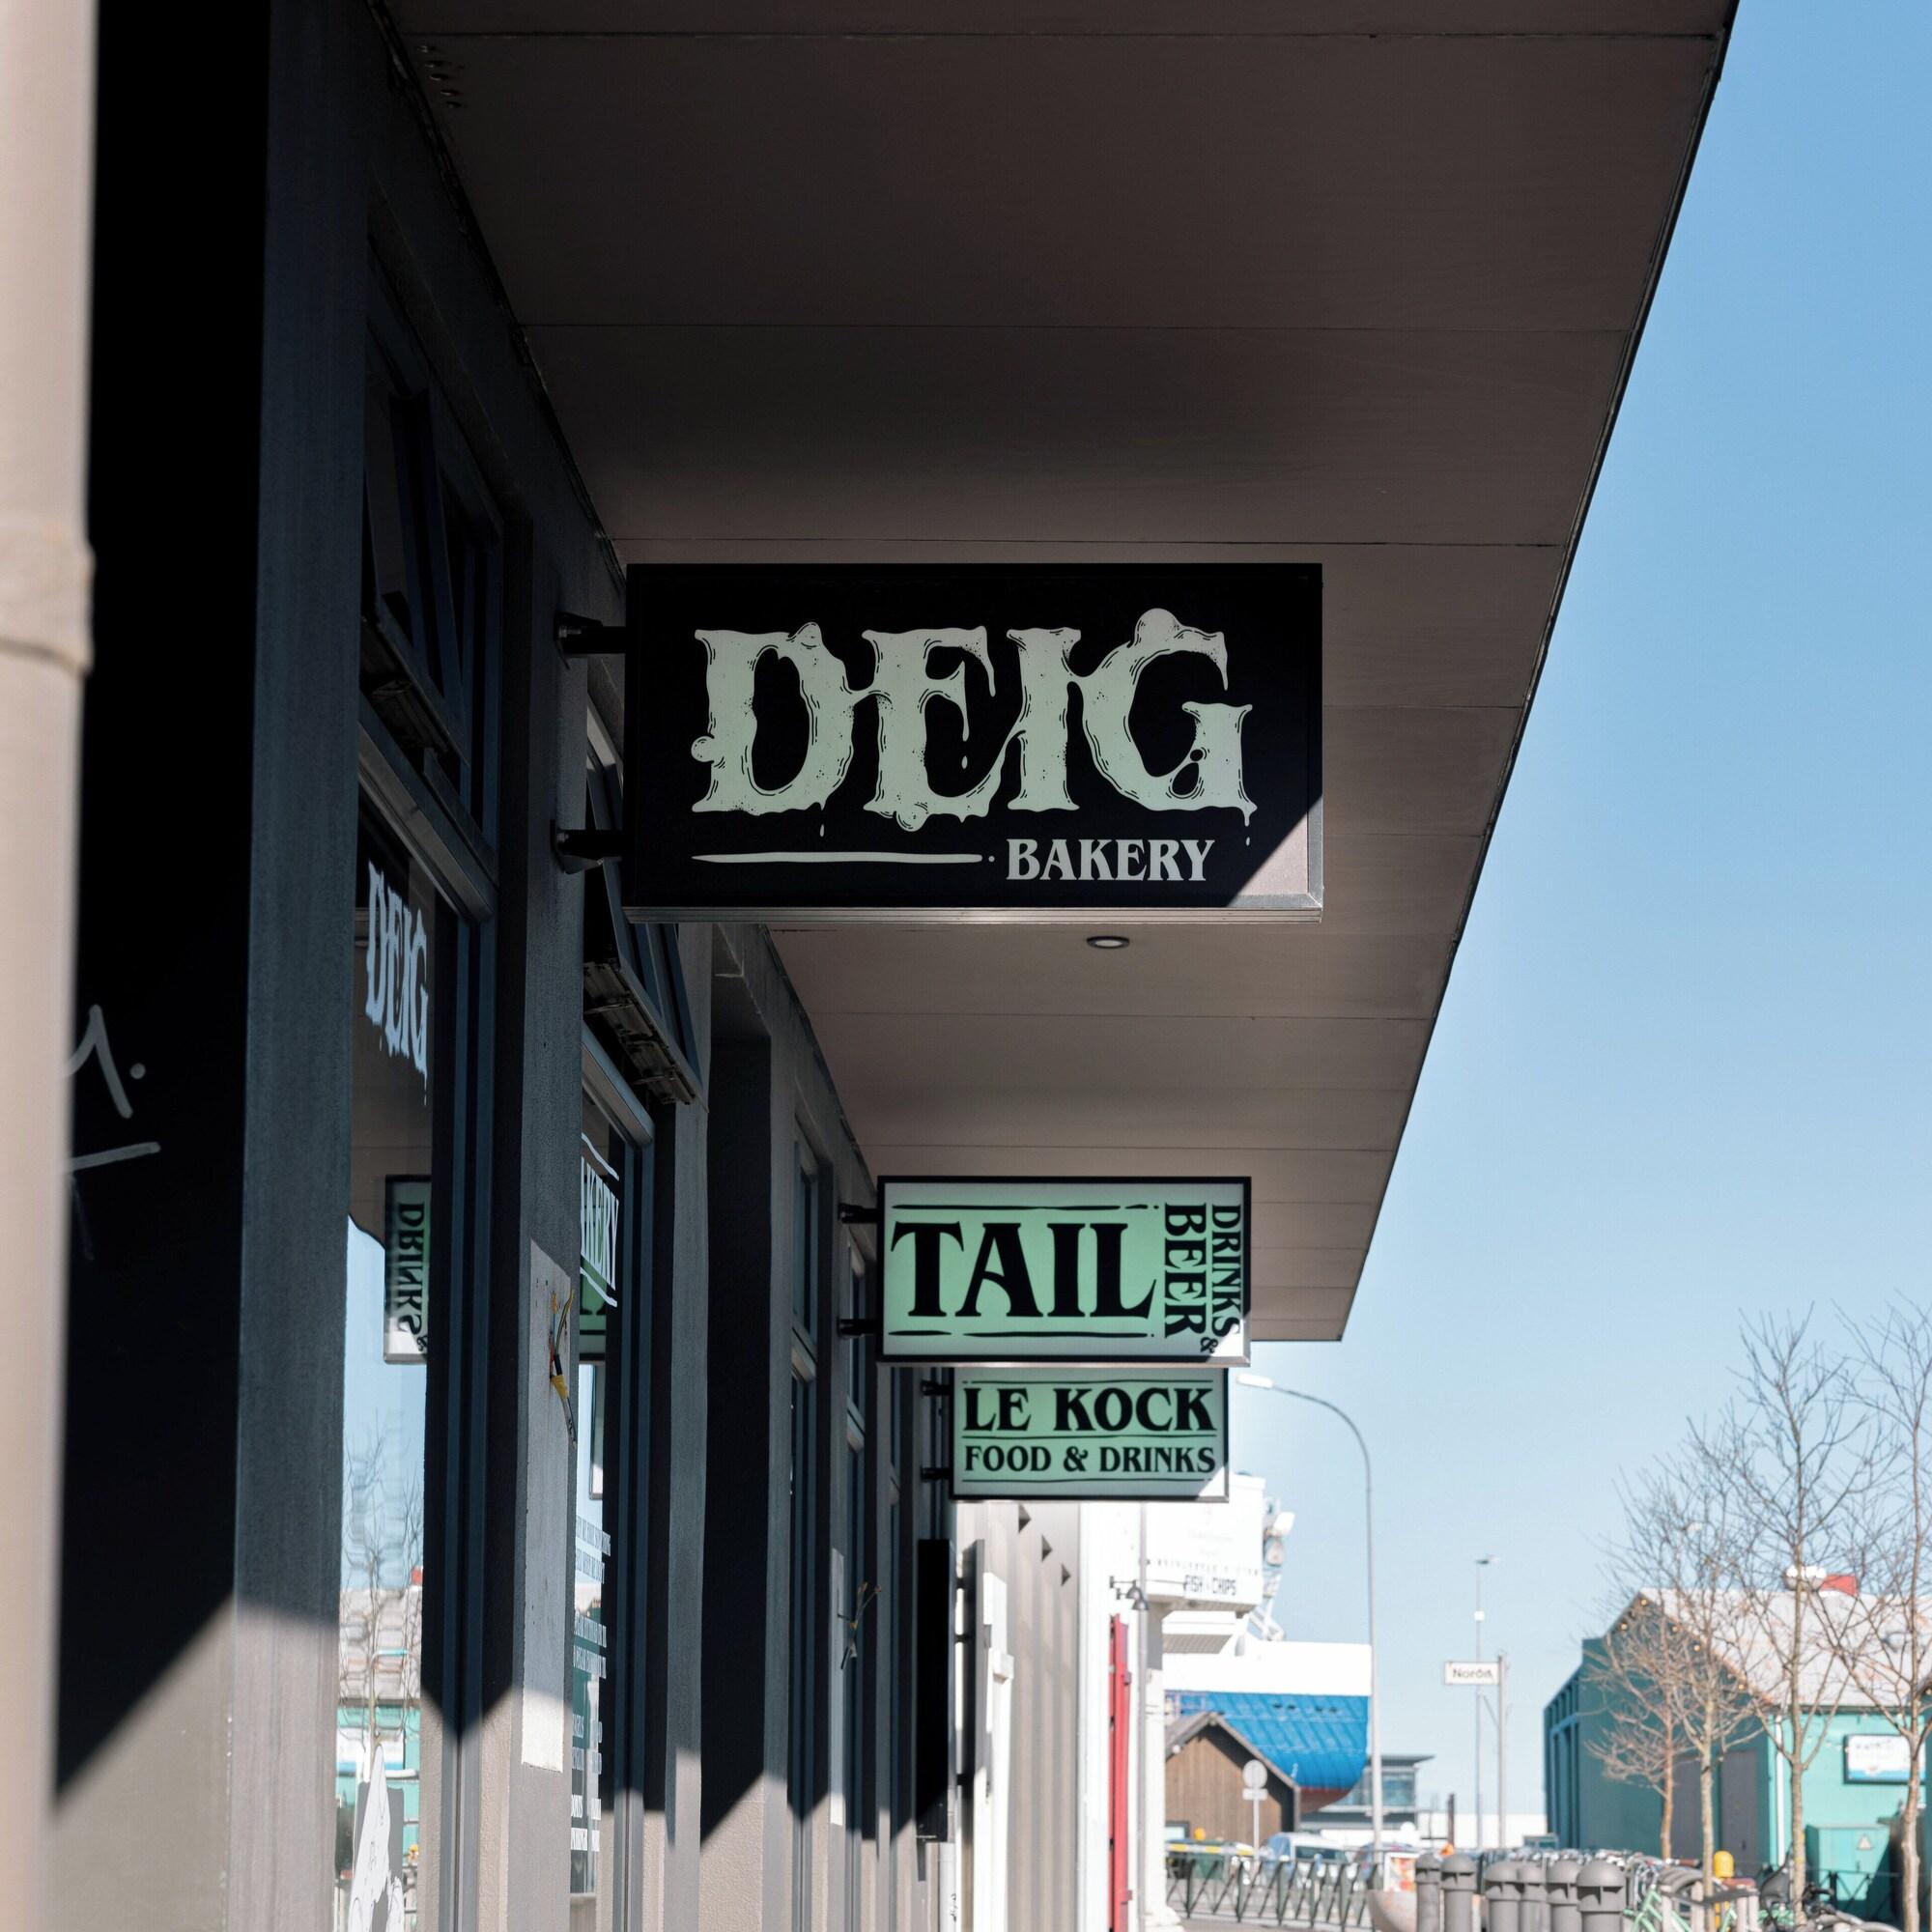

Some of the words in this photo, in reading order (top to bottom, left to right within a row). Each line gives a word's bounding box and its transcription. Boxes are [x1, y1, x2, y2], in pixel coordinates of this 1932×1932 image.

[692, 608, 1257, 835] DEIG
[1006, 838, 1216, 882] BAKERY
[365, 861, 429, 1084] DEIG
[581, 1156, 619, 1291] KERY
[890, 1220, 1157, 1320] TAIL
[1164, 1203, 1208, 1339] BEER
[1211, 1204, 1242, 1338] DRINKS
[962, 1387, 1033, 1432] LE
[1052, 1387, 1217, 1432] KOCK
[964, 1445, 1052, 1473] FOOD
[1063, 1445, 1089, 1473] &
[1098, 1445, 1216, 1473] DRINKS
